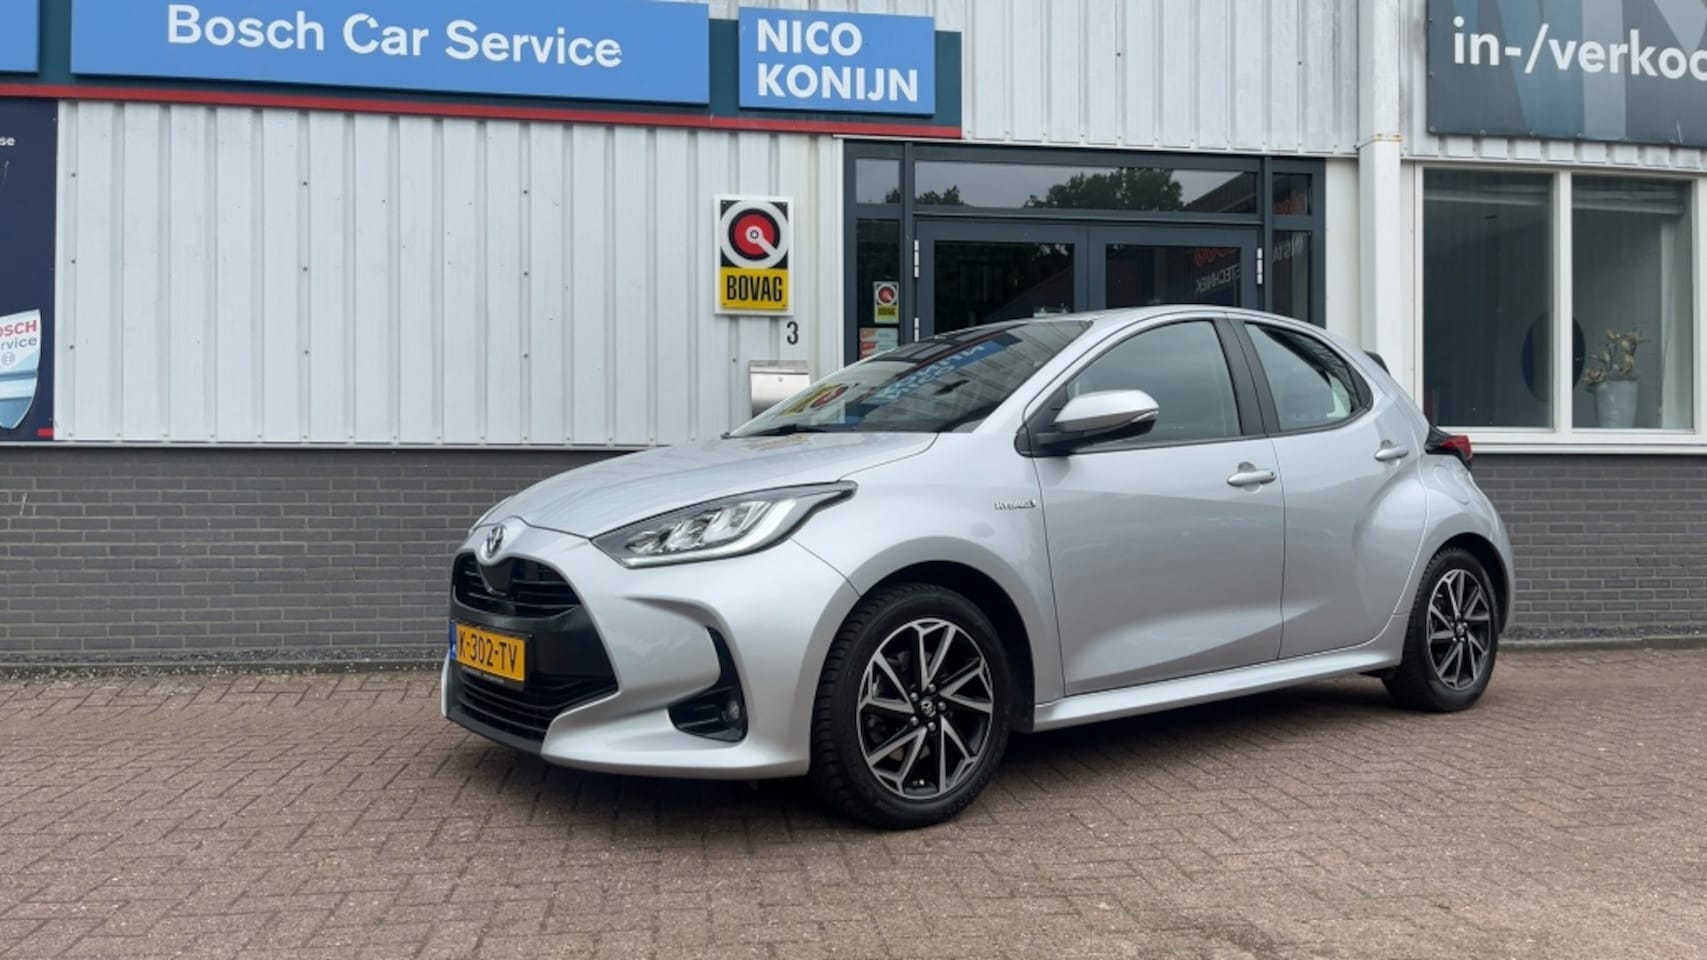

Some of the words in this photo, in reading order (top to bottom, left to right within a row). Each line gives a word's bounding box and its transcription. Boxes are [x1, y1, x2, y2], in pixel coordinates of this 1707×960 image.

[167, 3, 325, 51] Bosch
[342, 14, 429, 57] Car
[445, 19, 622, 68] Service
[757, 18, 863, 56] NICO
[757, 63, 919, 102] KONIJN
[726, 274, 783, 302] BOVAG
[786, 321, 799, 345] 3
[459, 631, 518, 673] K-302-TV
